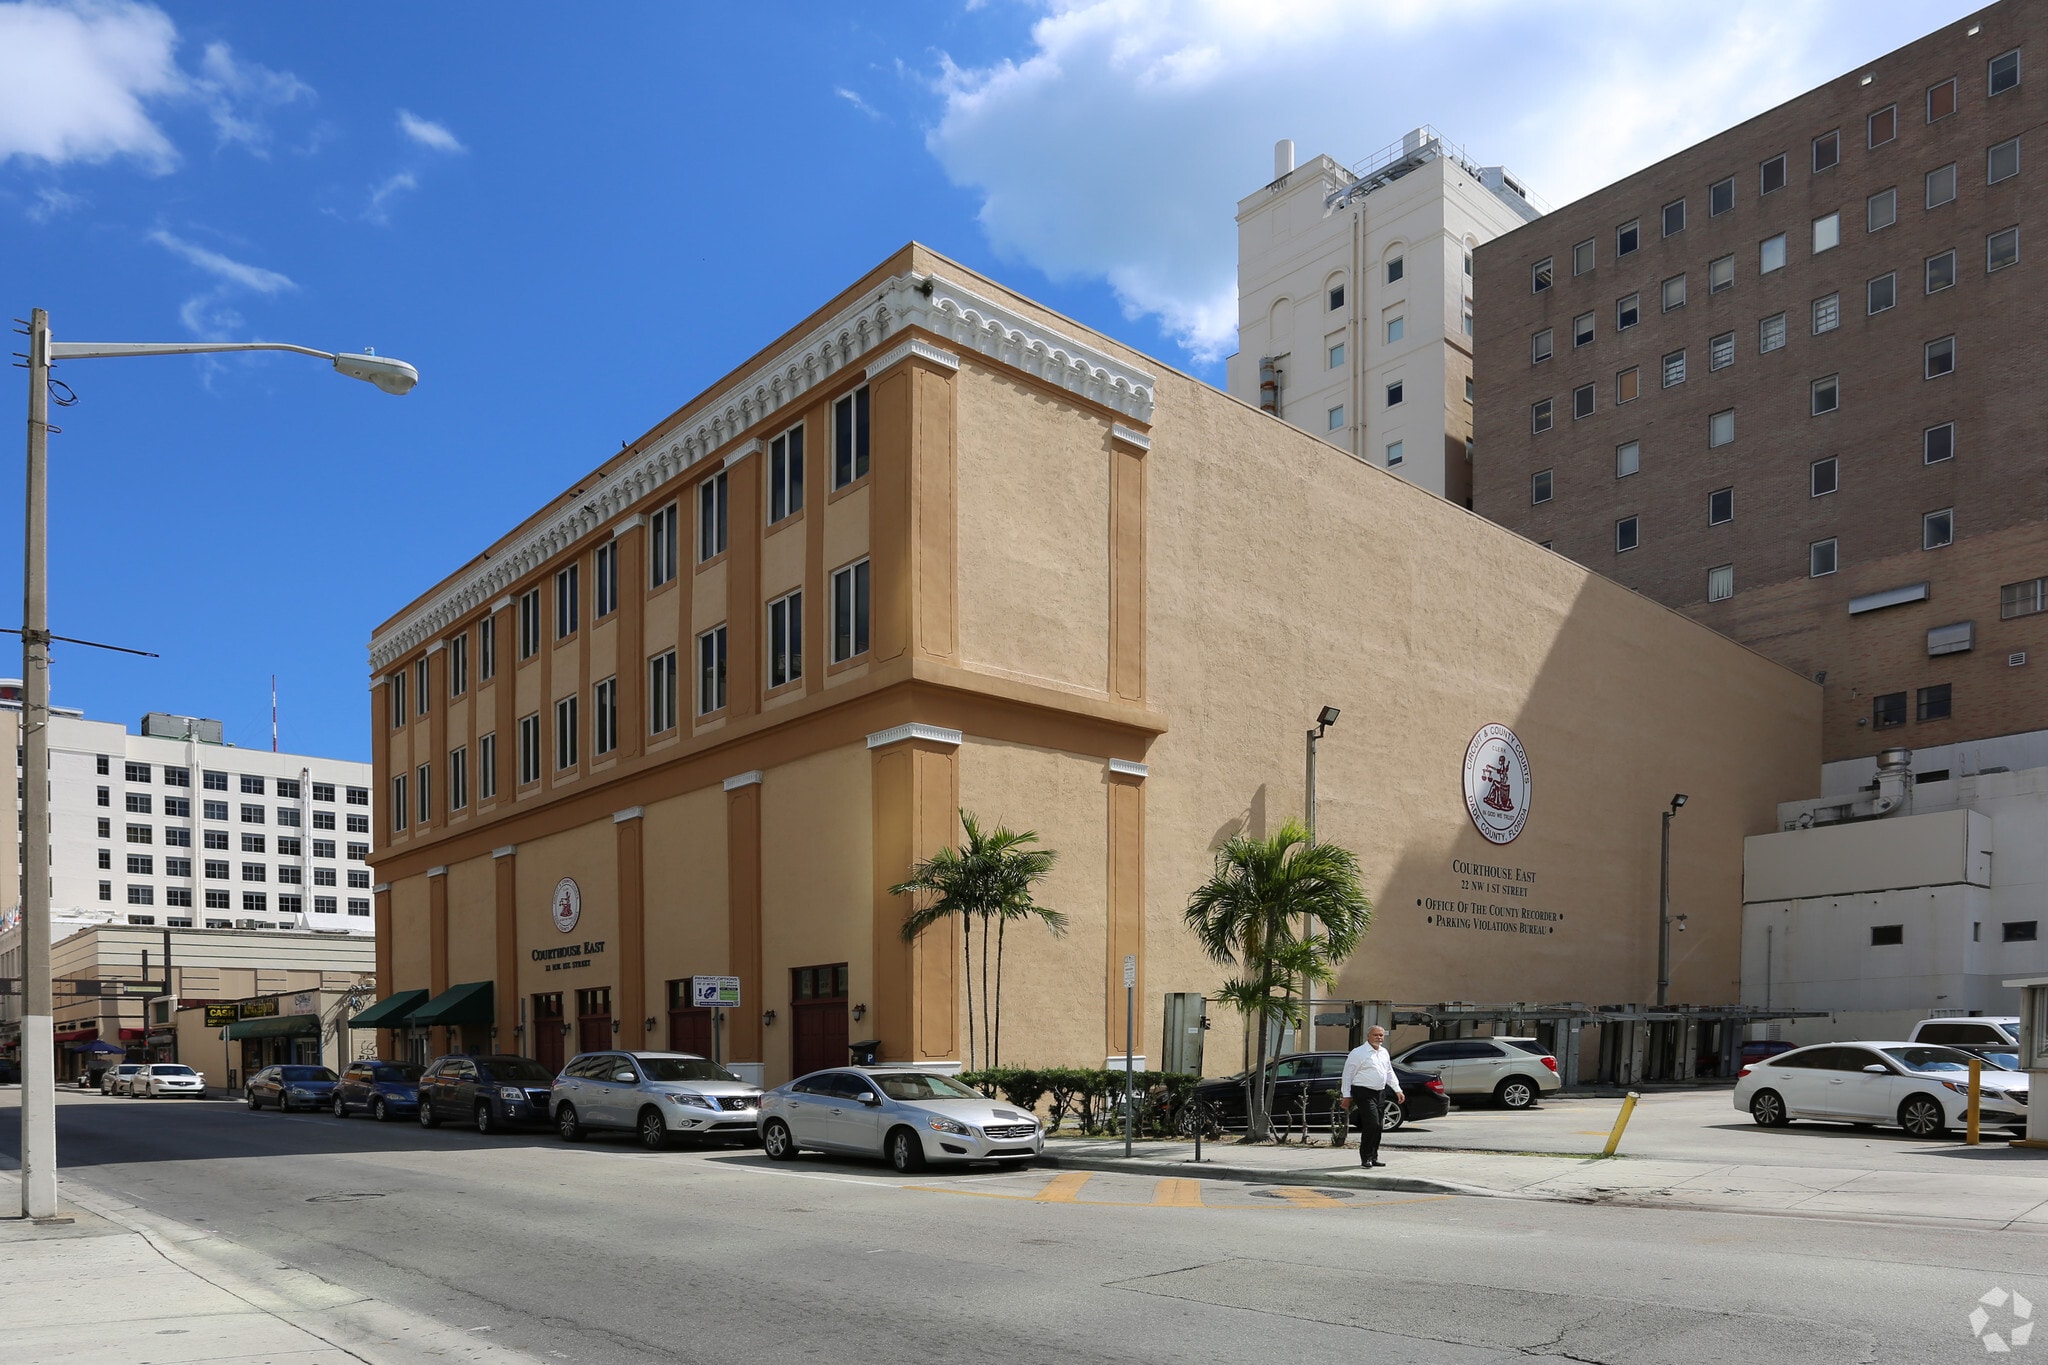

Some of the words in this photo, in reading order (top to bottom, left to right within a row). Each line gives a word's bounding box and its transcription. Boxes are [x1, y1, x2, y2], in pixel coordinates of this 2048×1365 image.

[1466, 733, 1483, 770] CIRCUIT
[1483, 729, 1489, 738] &
[1490, 726, 1516, 744] COUNTY
[1515, 744, 1530, 785] COURTS
[1468, 795, 1481, 823] DADE
[1508, 808, 1527, 839] FLORIDA
[1452, 859, 1513, 881] COURTHOUSE
[1515, 868, 1537, 884] EAST
[1461, 880, 1469, 890] 22
[1471, 880, 1485, 892] NW
[1502, 885, 1529, 898] STREET
[1425, 897, 1455, 912] OFFICE
[1457, 901, 1469, 914] OF
[1470, 902, 1488, 916] THE
[1489, 904, 1520, 919] COUNTY
[1521, 907, 1557, 922] RECORDER
[1436, 914, 1471, 930] PARKING
[1473, 918, 1518, 933] VIOLATIONS
[1519, 922, 1547, 936] BUREAU
[531, 944, 582, 962] COURTHOUSE
[583, 941, 605, 955] EAST
[209, 1008, 235, 1017] CASH
[867, 1053, 874, 1063] P
